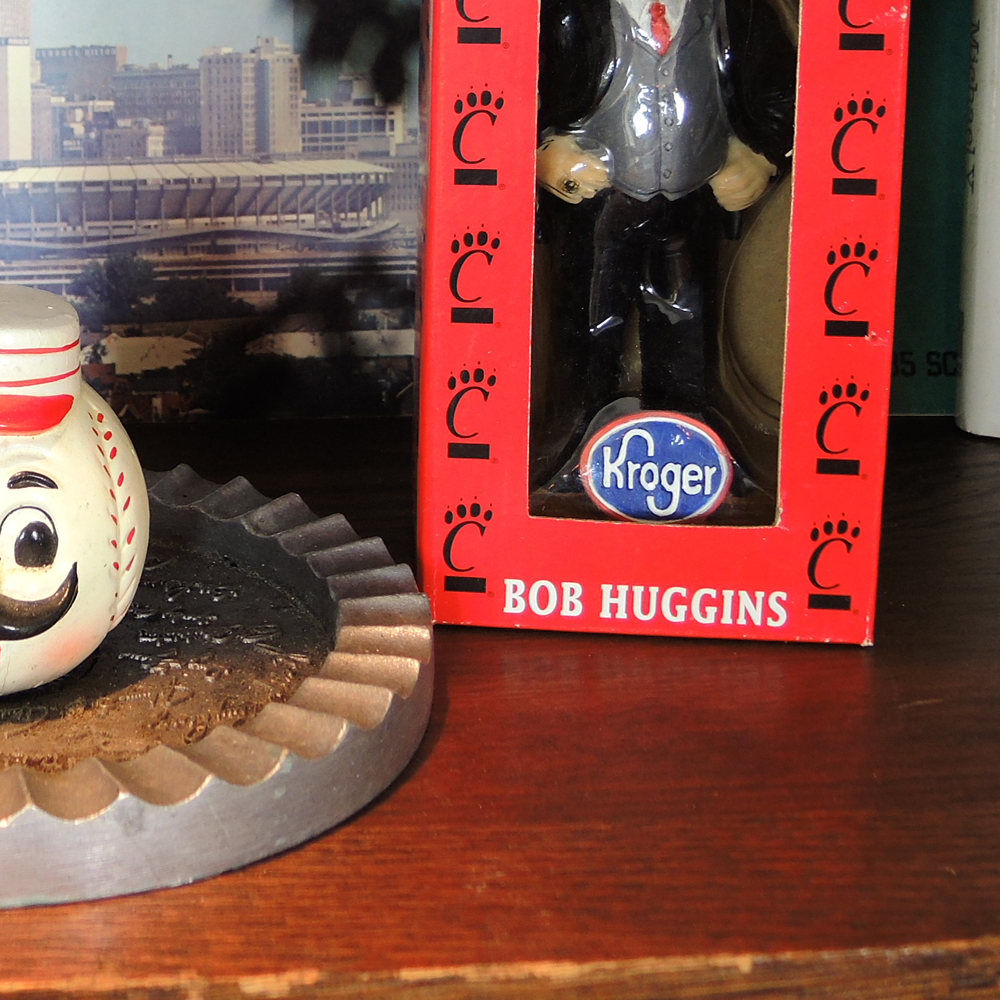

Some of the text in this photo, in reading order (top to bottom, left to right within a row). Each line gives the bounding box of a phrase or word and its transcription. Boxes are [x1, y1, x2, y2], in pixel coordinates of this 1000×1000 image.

[925, 351, 959, 377] SC
[602, 428, 718, 517] Kroger
[504, 578, 788, 629] BOB HUGGINS
